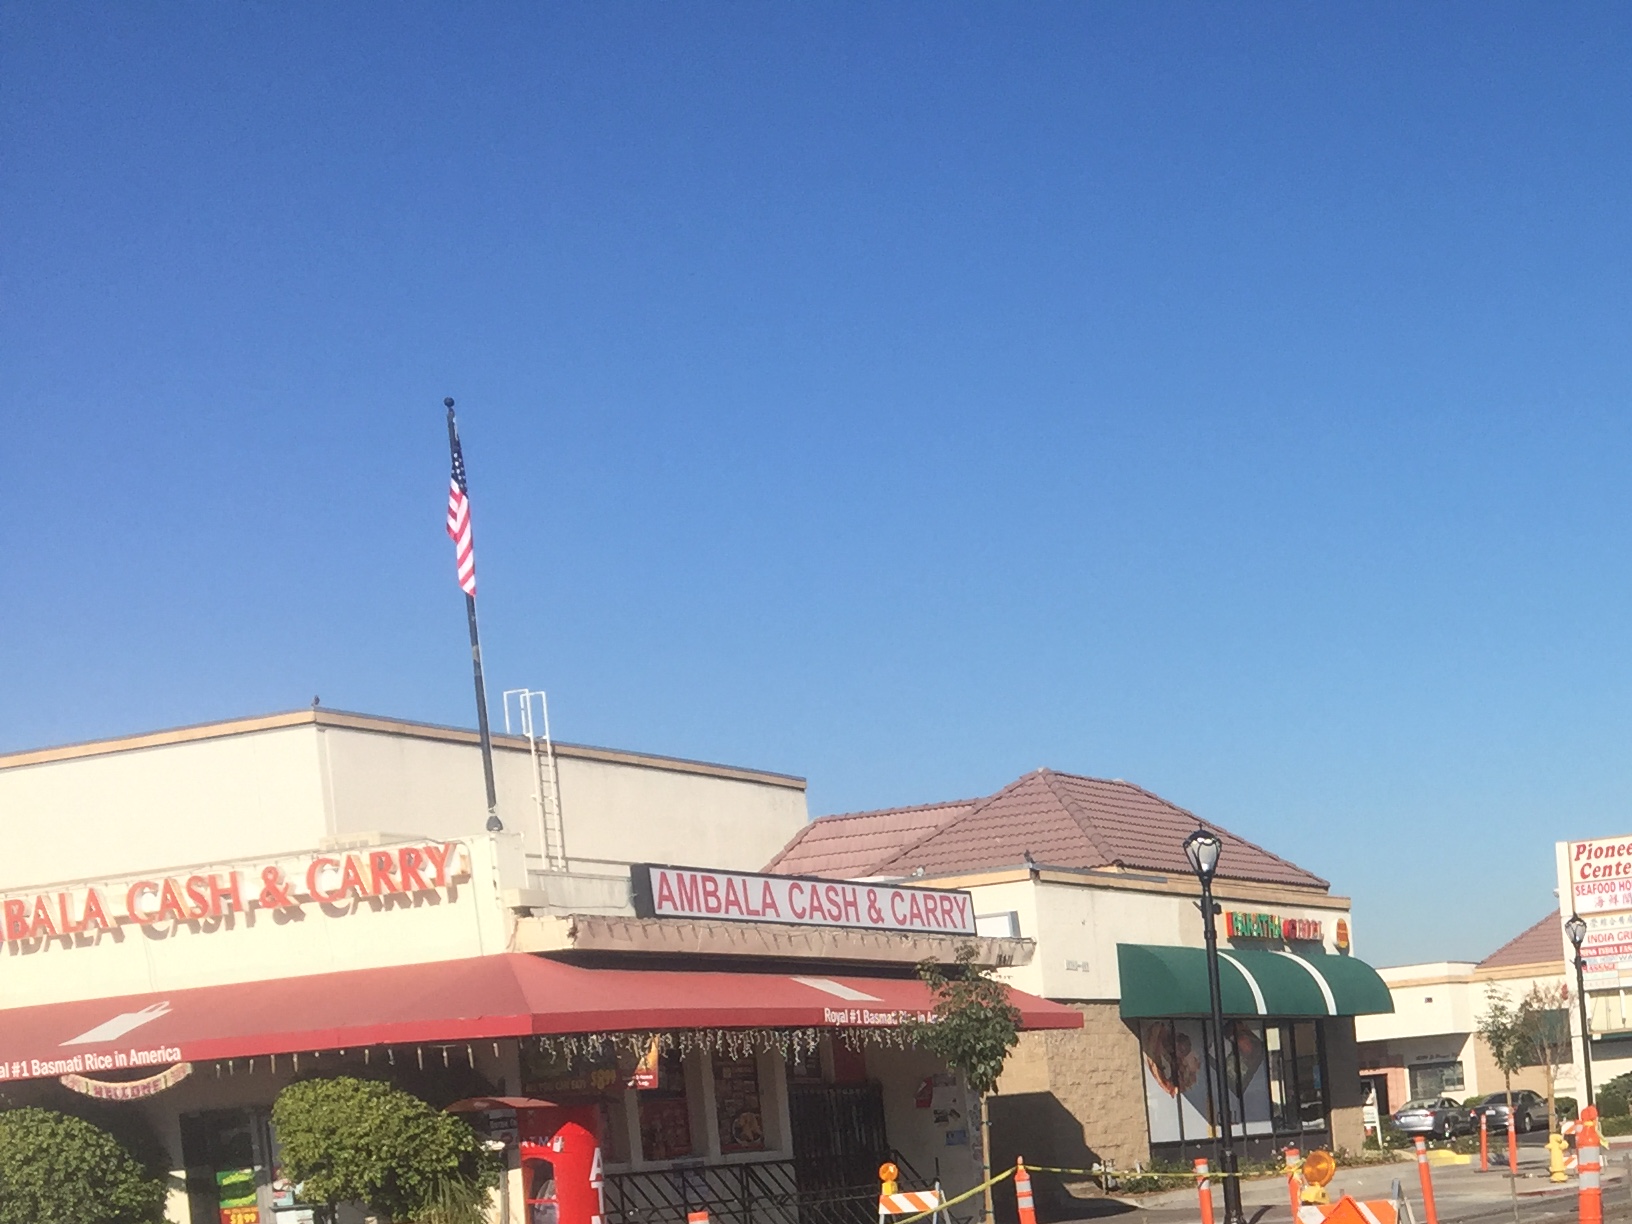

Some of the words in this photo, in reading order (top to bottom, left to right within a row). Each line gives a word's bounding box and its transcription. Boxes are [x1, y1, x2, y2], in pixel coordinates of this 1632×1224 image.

[0, 887, 110, 942] BALA
[127, 870, 244, 926] CASH
[259, 865, 292, 909] &
[305, 842, 457, 902] CARRY
[656, 871, 781, 918] AMBALA
[787, 881, 861, 923] CASH
[866, 887, 885, 924] &
[890, 890, 968, 930] CARRY
[1575, 881, 1617, 897] SEAFOOD
[1587, 932, 1615, 944] INDIA
[823, 1007, 849, 1026] Royal
[849, 1009, 863, 1024] #1
[917, 1011, 926, 1023] in
[12, 1060, 29, 1078] #1
[31, 1054, 83, 1075] Basmati
[84, 1052, 113, 1071] Rice
[114, 1050, 128, 1067] in
[130, 1045, 182, 1066] America
